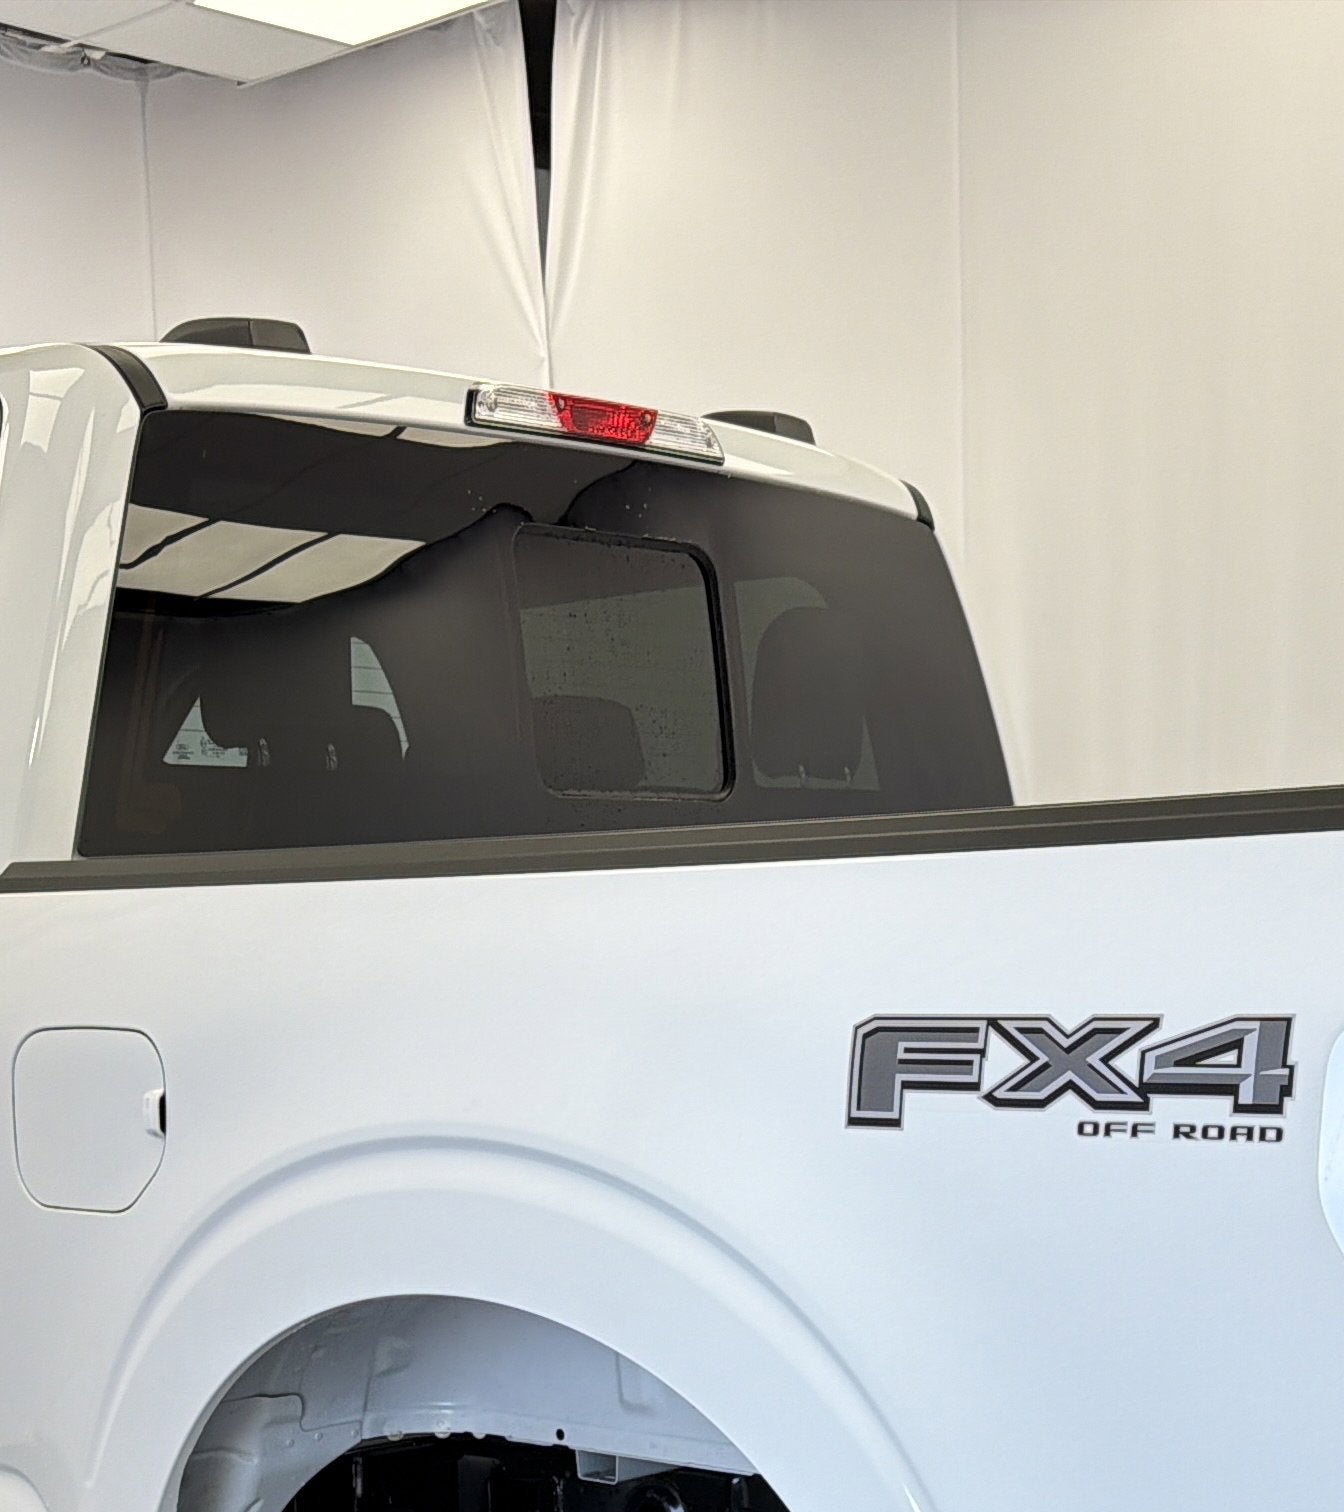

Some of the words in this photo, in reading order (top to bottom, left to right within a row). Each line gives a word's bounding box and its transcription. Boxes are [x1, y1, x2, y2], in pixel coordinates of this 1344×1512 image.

[846, 1014, 1297, 1129] FX4
[1077, 1120, 1157, 1139] OFF
[1172, 1123, 1285, 1143] ROAD
